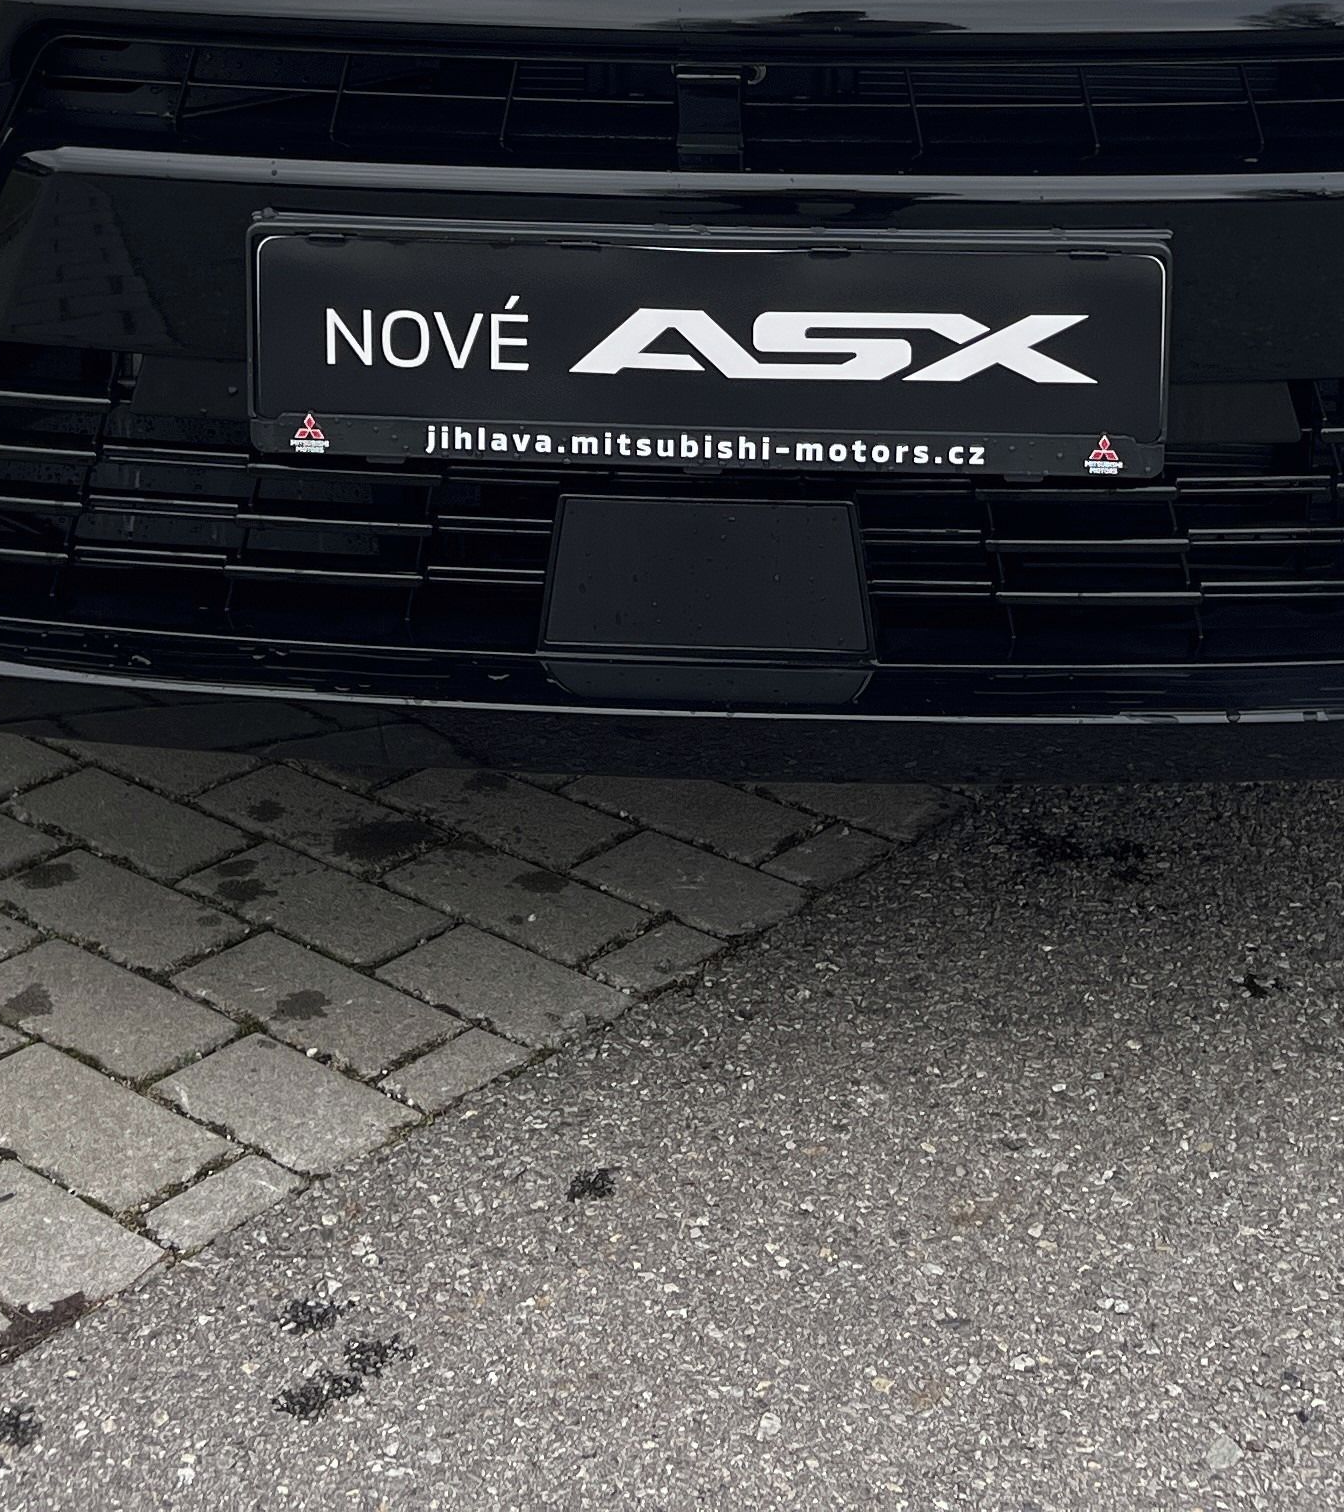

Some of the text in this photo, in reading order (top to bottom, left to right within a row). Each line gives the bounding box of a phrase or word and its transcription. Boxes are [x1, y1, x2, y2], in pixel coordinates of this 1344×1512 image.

[326, 295, 1098, 384] NOVÉ ASX
[425, 425, 986, 465] jihlava.mitsubishi-motors.cz
